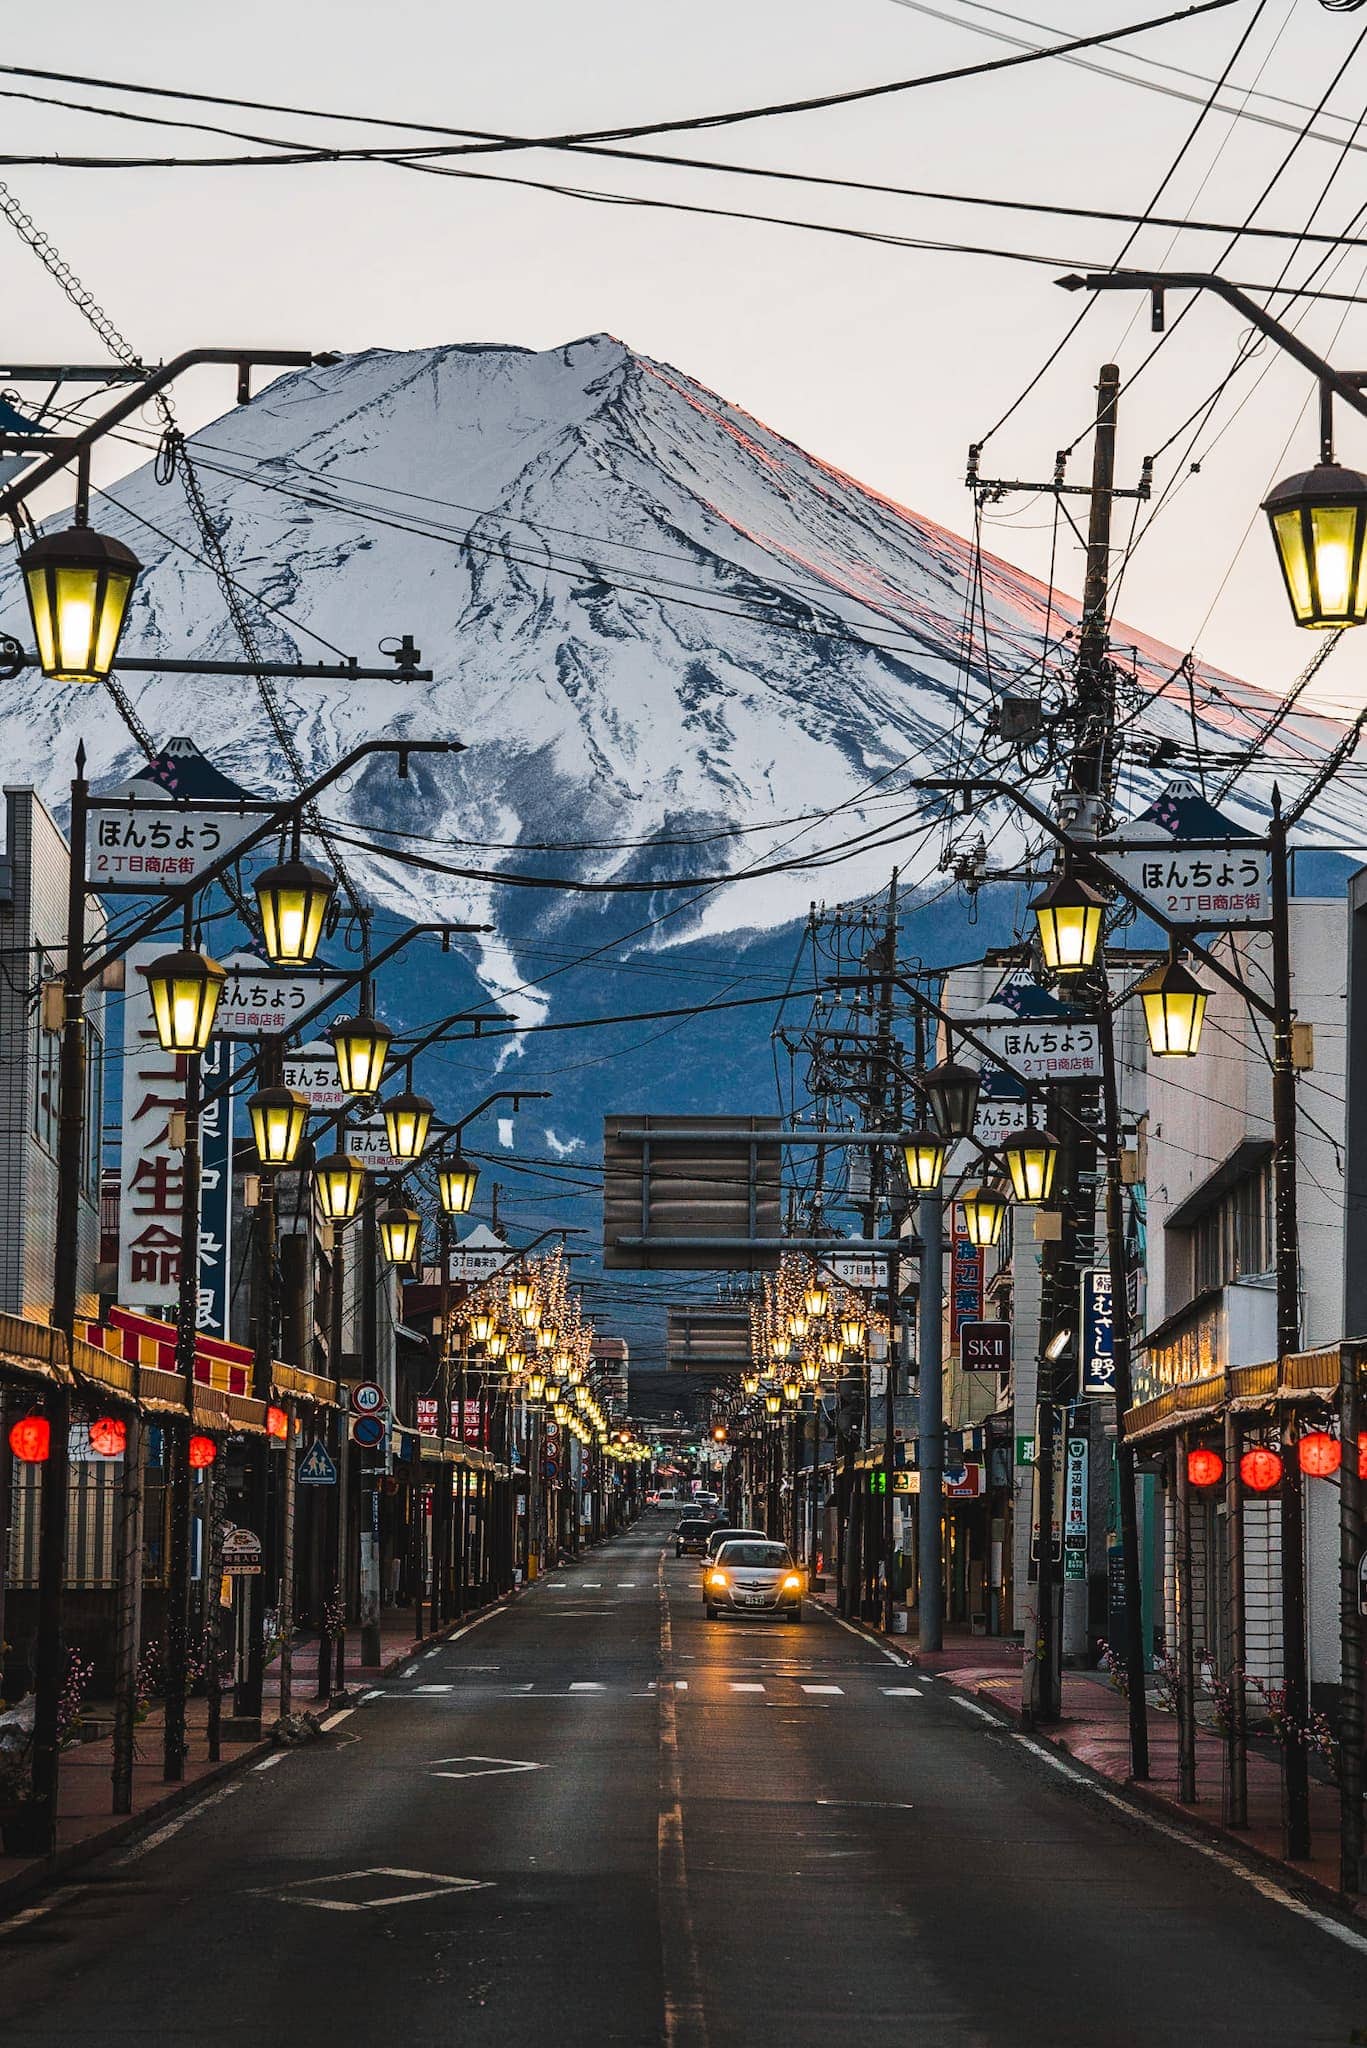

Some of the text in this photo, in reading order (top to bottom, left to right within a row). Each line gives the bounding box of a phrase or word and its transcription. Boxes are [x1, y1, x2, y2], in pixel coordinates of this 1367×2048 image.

[98, 820, 220, 851] ほんちょう
[97, 855, 195, 874] 2丁目商店街
[1142, 860, 1259, 889] ほんちょう
[1166, 894, 1260, 912] 2丁目商店街
[1005, 1033, 1092, 1056] ほんちょう
[1024, 1056, 1094, 1072] 2丁目商店街
[1091, 1294, 1115, 1380] むさし野
[360, 1391, 377, 1405] 40
